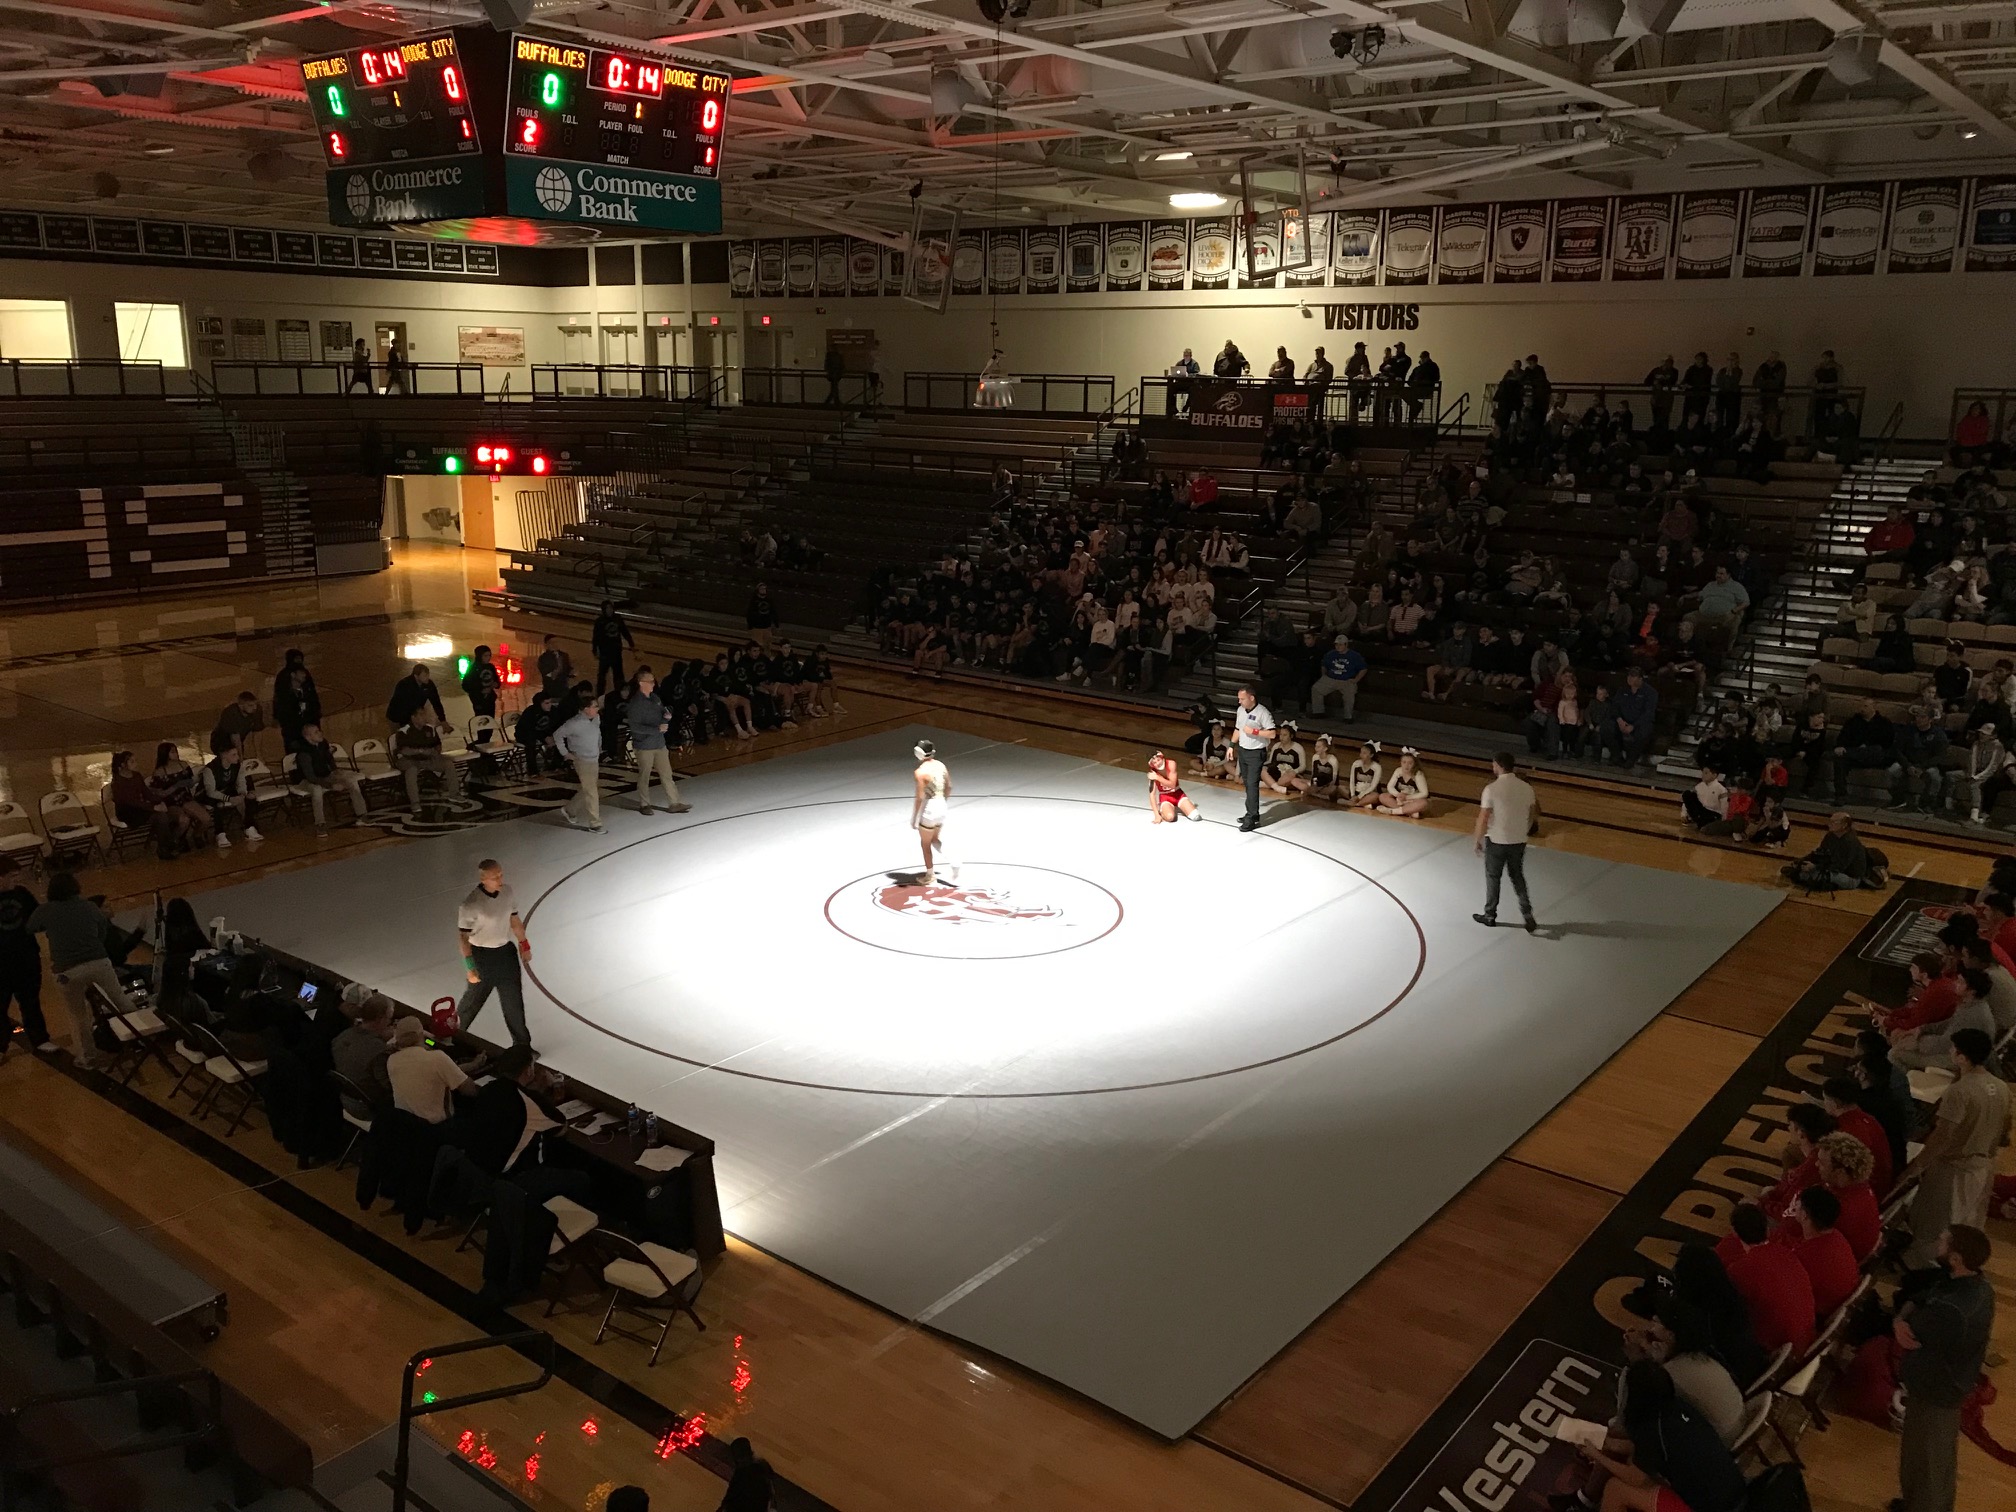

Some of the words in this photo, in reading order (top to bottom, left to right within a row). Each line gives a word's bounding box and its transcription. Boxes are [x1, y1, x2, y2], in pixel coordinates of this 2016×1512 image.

[401, 43, 430, 63] DODGE
[432, 38, 454, 58] CITY
[518, 41, 586, 69] BUFFALOES
[303, 57, 348, 80] BUFFALOES
[361, 51, 404, 84] 0:14
[608, 58, 658, 92] 0:14
[443, 67, 460, 99] 0
[664, 67, 698, 89] DODGE
[702, 75, 727, 93] CITY
[543, 73, 559, 105] 0
[327, 85, 344, 116] 0
[604, 102, 627, 113] PERIOD
[516, 107, 539, 119] FOULS
[562, 114, 578, 125] T.O.L.
[703, 100, 718, 130] 0
[524, 119, 537, 142] 2
[599, 120, 623, 132] PLAYER
[628, 124, 644, 135] FOUL
[663, 129, 677, 139] T.O.L.
[696, 134, 714, 144] FOULS
[515, 142, 537, 154] SCORE
[607, 154, 629, 165] MATCH
[694, 165, 713, 175] SCORE
[371, 166, 462, 191] Commerce
[577, 168, 697, 202] Commerce
[1719, 198, 1735, 206] CITY
[1789, 193, 1806, 201] CITY
[373, 191, 418, 222] Bank
[579, 194, 638, 222] Bank
[1895, 226, 1956, 234] Commerce
[1562, 238, 1598, 248] Burtis
[1910, 235, 1938, 244] Bank
[1110, 245, 1141, 253] AMERICAN
[1325, 303, 1420, 331] VISITORS
[1273, 406, 1310, 417] PROTECT
[1191, 411, 1263, 429] BUFFALOES
[432, 447, 467, 455] BUFFALOES
[520, 448, 542, 456] GUEST
